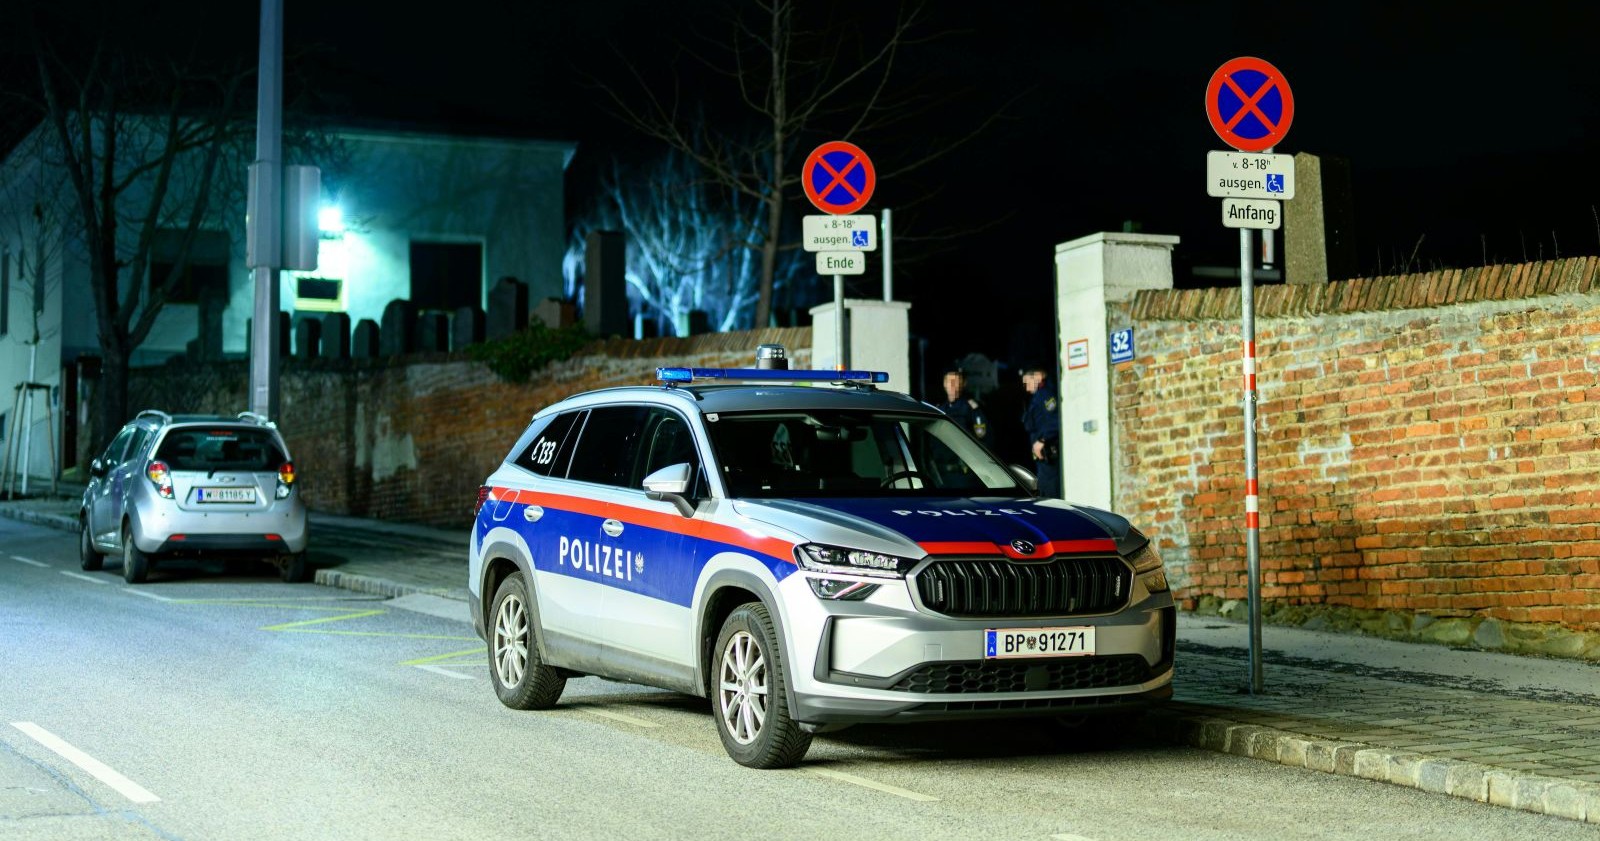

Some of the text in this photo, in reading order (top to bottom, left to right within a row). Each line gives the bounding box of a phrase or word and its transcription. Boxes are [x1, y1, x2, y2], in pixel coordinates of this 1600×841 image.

[1219, 178, 1265, 191] ausgen.
[1229, 204, 1275, 224] Anfang
[813, 236, 851, 246] ausgen.
[827, 256, 854, 269] Ende
[1113, 331, 1129, 352] 52
[537, 440, 557, 465] 133
[891, 508, 1038, 517] POLIZEI
[559, 535, 632, 582] POLIZEI
[1005, 631, 1085, 653] BP 91271
